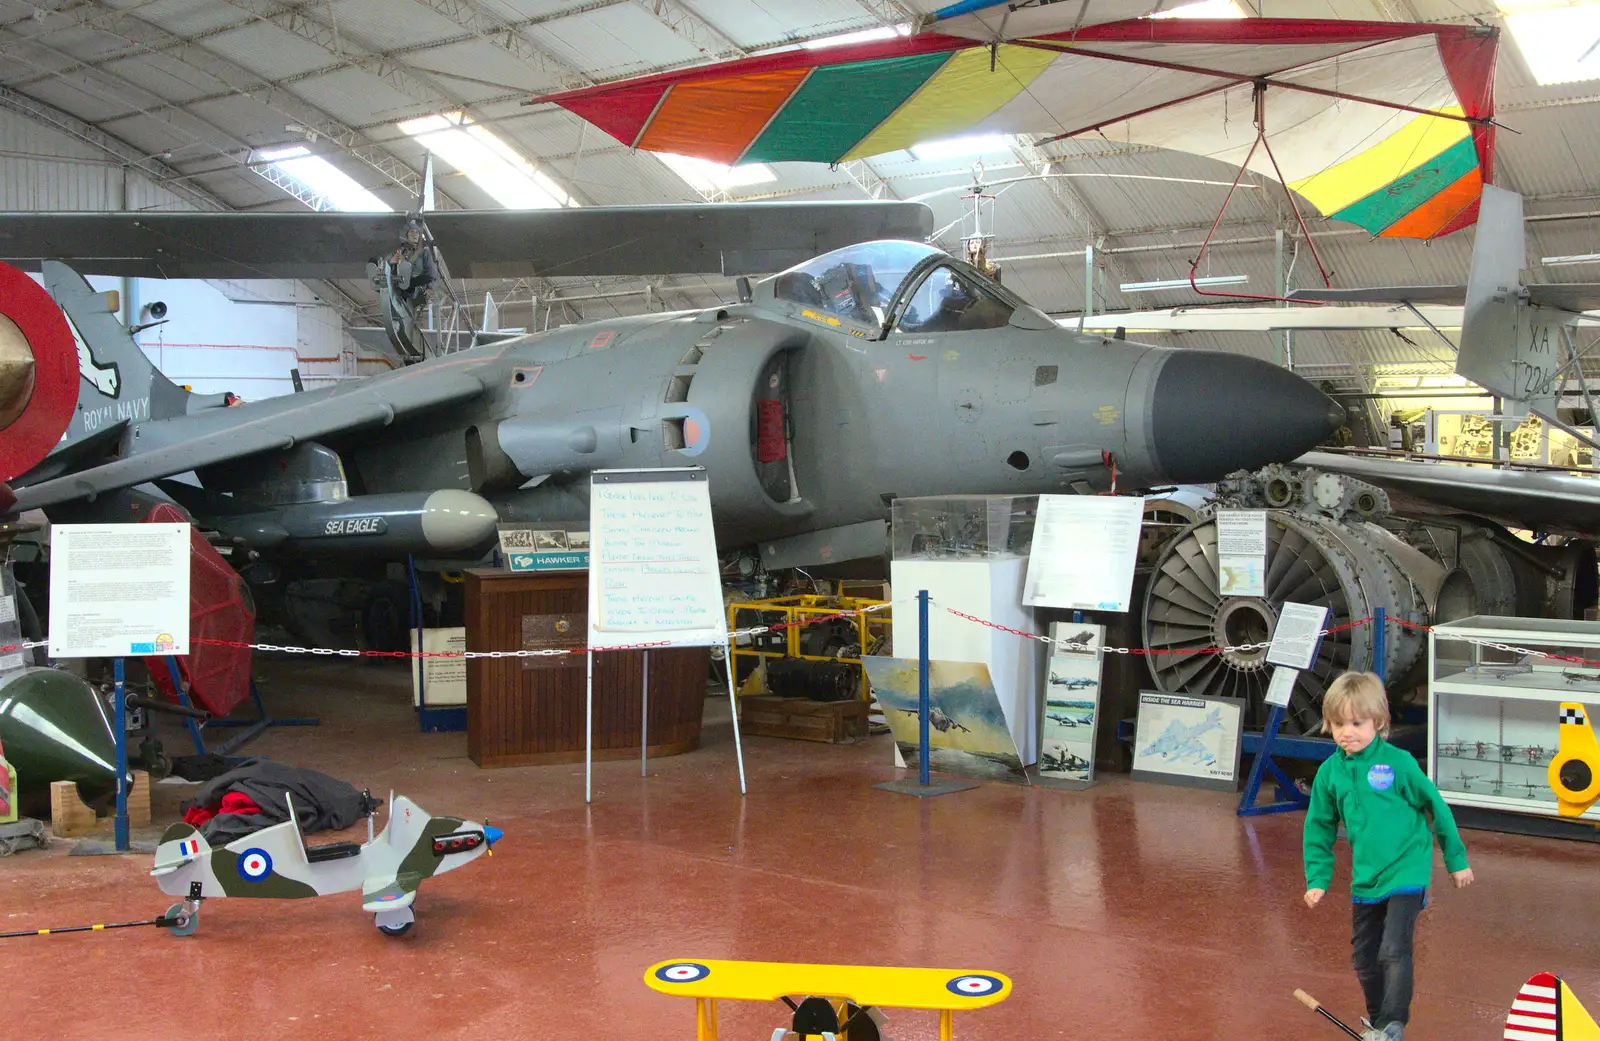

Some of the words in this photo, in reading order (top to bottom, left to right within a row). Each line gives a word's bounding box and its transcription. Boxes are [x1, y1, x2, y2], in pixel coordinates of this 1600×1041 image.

[1529, 323, 1550, 354] XA
[1524, 365, 1550, 395] 226
[117, 396, 149, 420] NAVY
[325, 520, 345, 535] SEA
[346, 518, 380, 533] EAGLE
[536, 555, 581, 565] HAWKER
[1142, 696, 1160, 704] INSIDE
[1181, 700, 1206, 708] HARRIER
